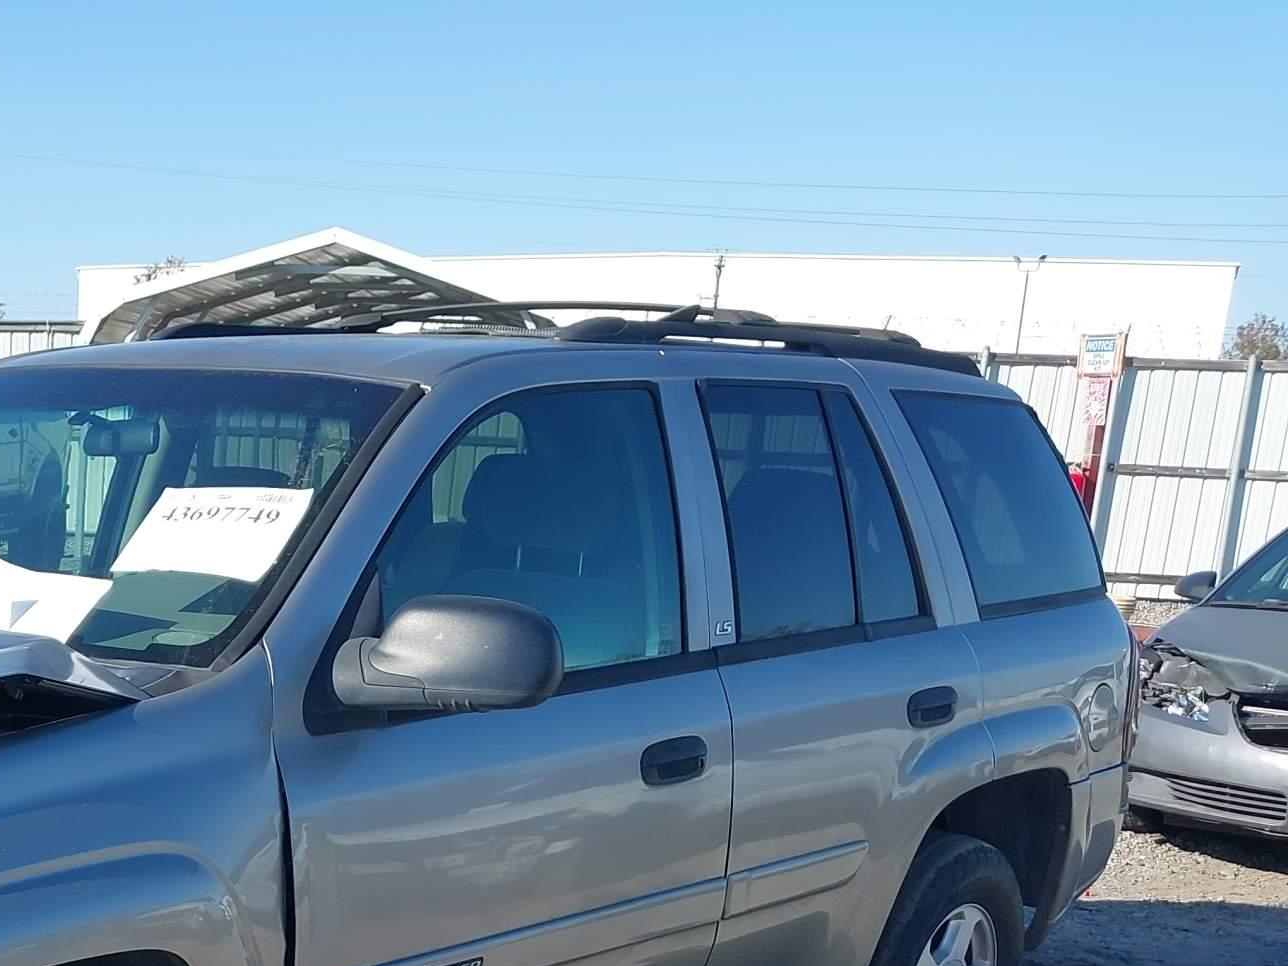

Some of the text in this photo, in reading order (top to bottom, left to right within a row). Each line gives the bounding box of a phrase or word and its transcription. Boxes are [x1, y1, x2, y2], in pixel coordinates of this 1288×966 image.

[1086, 340, 1115, 351] NOTICE
[161, 506, 281, 525] 43697749
[715, 621, 733, 635] LS
